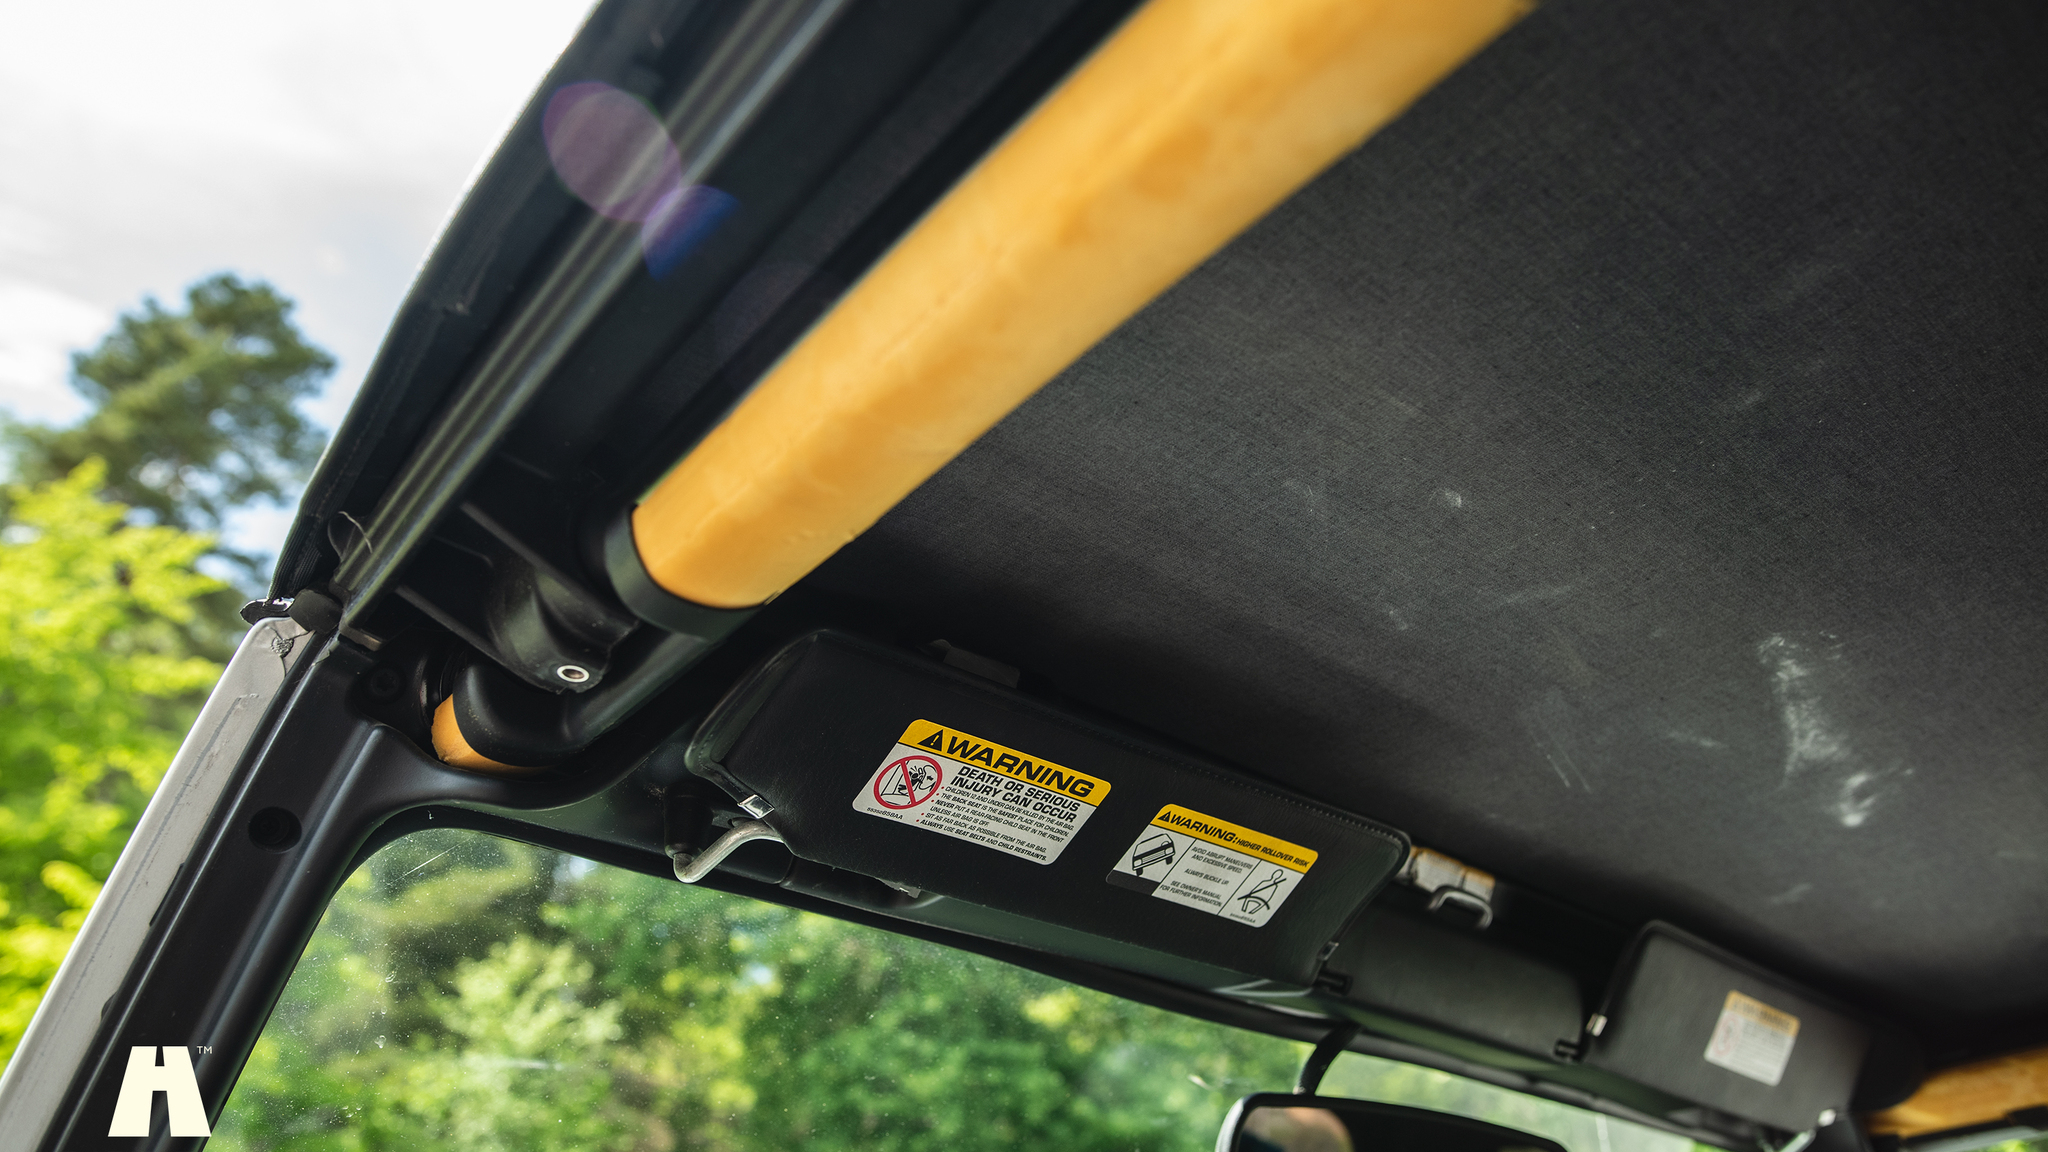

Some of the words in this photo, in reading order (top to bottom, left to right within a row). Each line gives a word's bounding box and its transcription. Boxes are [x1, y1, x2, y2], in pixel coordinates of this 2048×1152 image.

[944, 736, 1096, 798] WARNING
[945, 786, 971, 797] CHILDREN
[987, 799, 1005, 808] UNDER
[1021, 810, 1039, 818] KILLED
[950, 776, 1002, 797] INJURY
[1001, 792, 1032, 807] CAN
[1032, 802, 1077, 822] OCCUR
[958, 766, 1003, 786] DEATH
[1003, 781, 1024, 793] OR
[1024, 787, 1081, 811] SERIOUS
[930, 806, 951, 816] UNLESS
[935, 799, 955, 808] NEVER
[1002, 819, 1018, 827] CHILD
[1047, 834, 1064, 842] FRONT
[951, 796, 968, 804] BACK
[997, 810, 1018, 819] SAFEST
[1017, 816, 1034, 825] PLACE
[920, 819, 944, 829] ALWAYS
[968, 833, 986, 841] BELTS
[997, 842, 1014, 850] CHILD
[1013, 847, 1048, 861] RESTRAINTS.
[976, 827, 1000, 838] POSSIBLE
[1169, 814, 1239, 843] WARNING:
[1236, 838, 1262, 851] HIGHER
[1260, 846, 1294, 861] ROLLOVER
[1292, 857, 1310, 867] RISK
[1202, 857, 1228, 868] EXCESSIVE
[1206, 851, 1225, 860] ABRUPT
[1184, 868, 1204, 877] ALWAYS
[1203, 874, 1221, 883] BUCKLE
[1169, 887, 1191, 897] FURTHER
[1202, 890, 1221, 899] MANUAL
